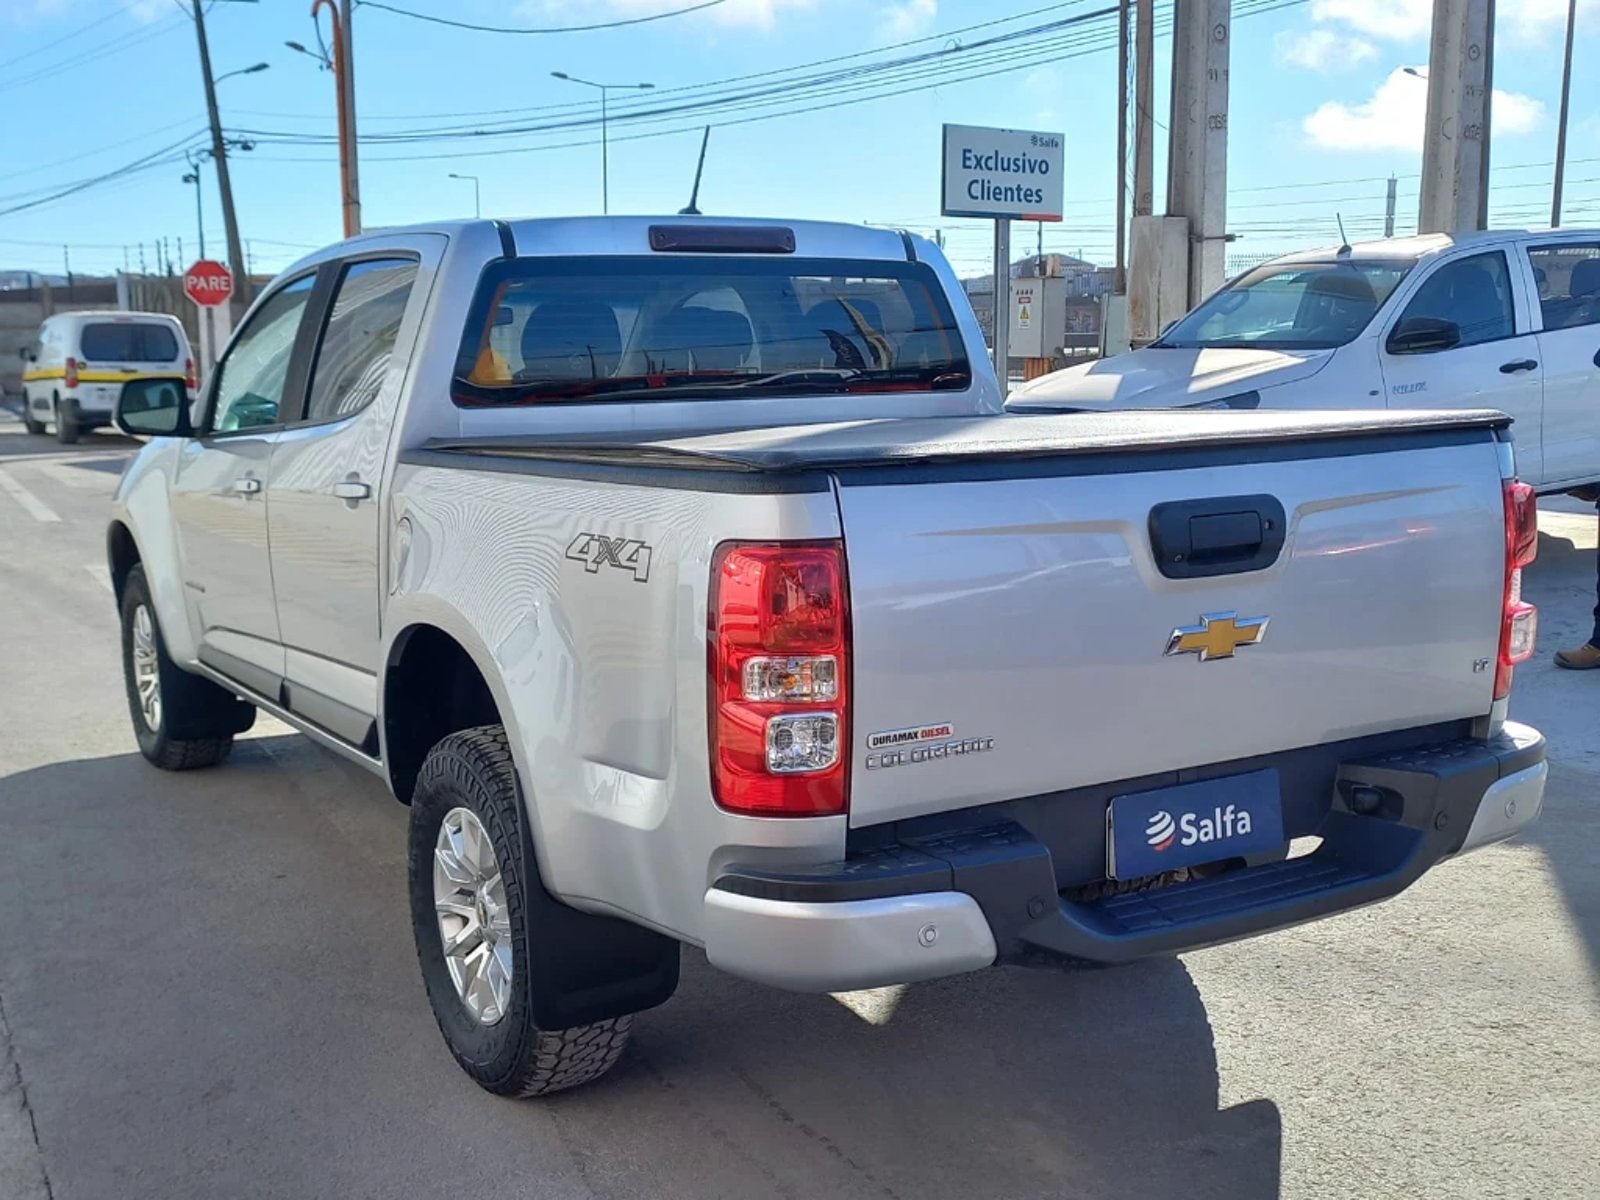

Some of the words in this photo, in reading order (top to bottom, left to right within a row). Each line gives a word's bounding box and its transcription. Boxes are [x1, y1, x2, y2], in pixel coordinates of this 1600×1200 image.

[1038, 137, 1059, 148] Salfa
[962, 148, 1050, 175] Exclusivo
[967, 178, 1043, 204] Clientes
[187, 275, 230, 291] PARE
[872, 730, 920, 746] DURAMAX
[920, 726, 951, 738] DIESEL
[865, 738, 994, 771] COLORADO
[1180, 804, 1252, 846] Salfa
